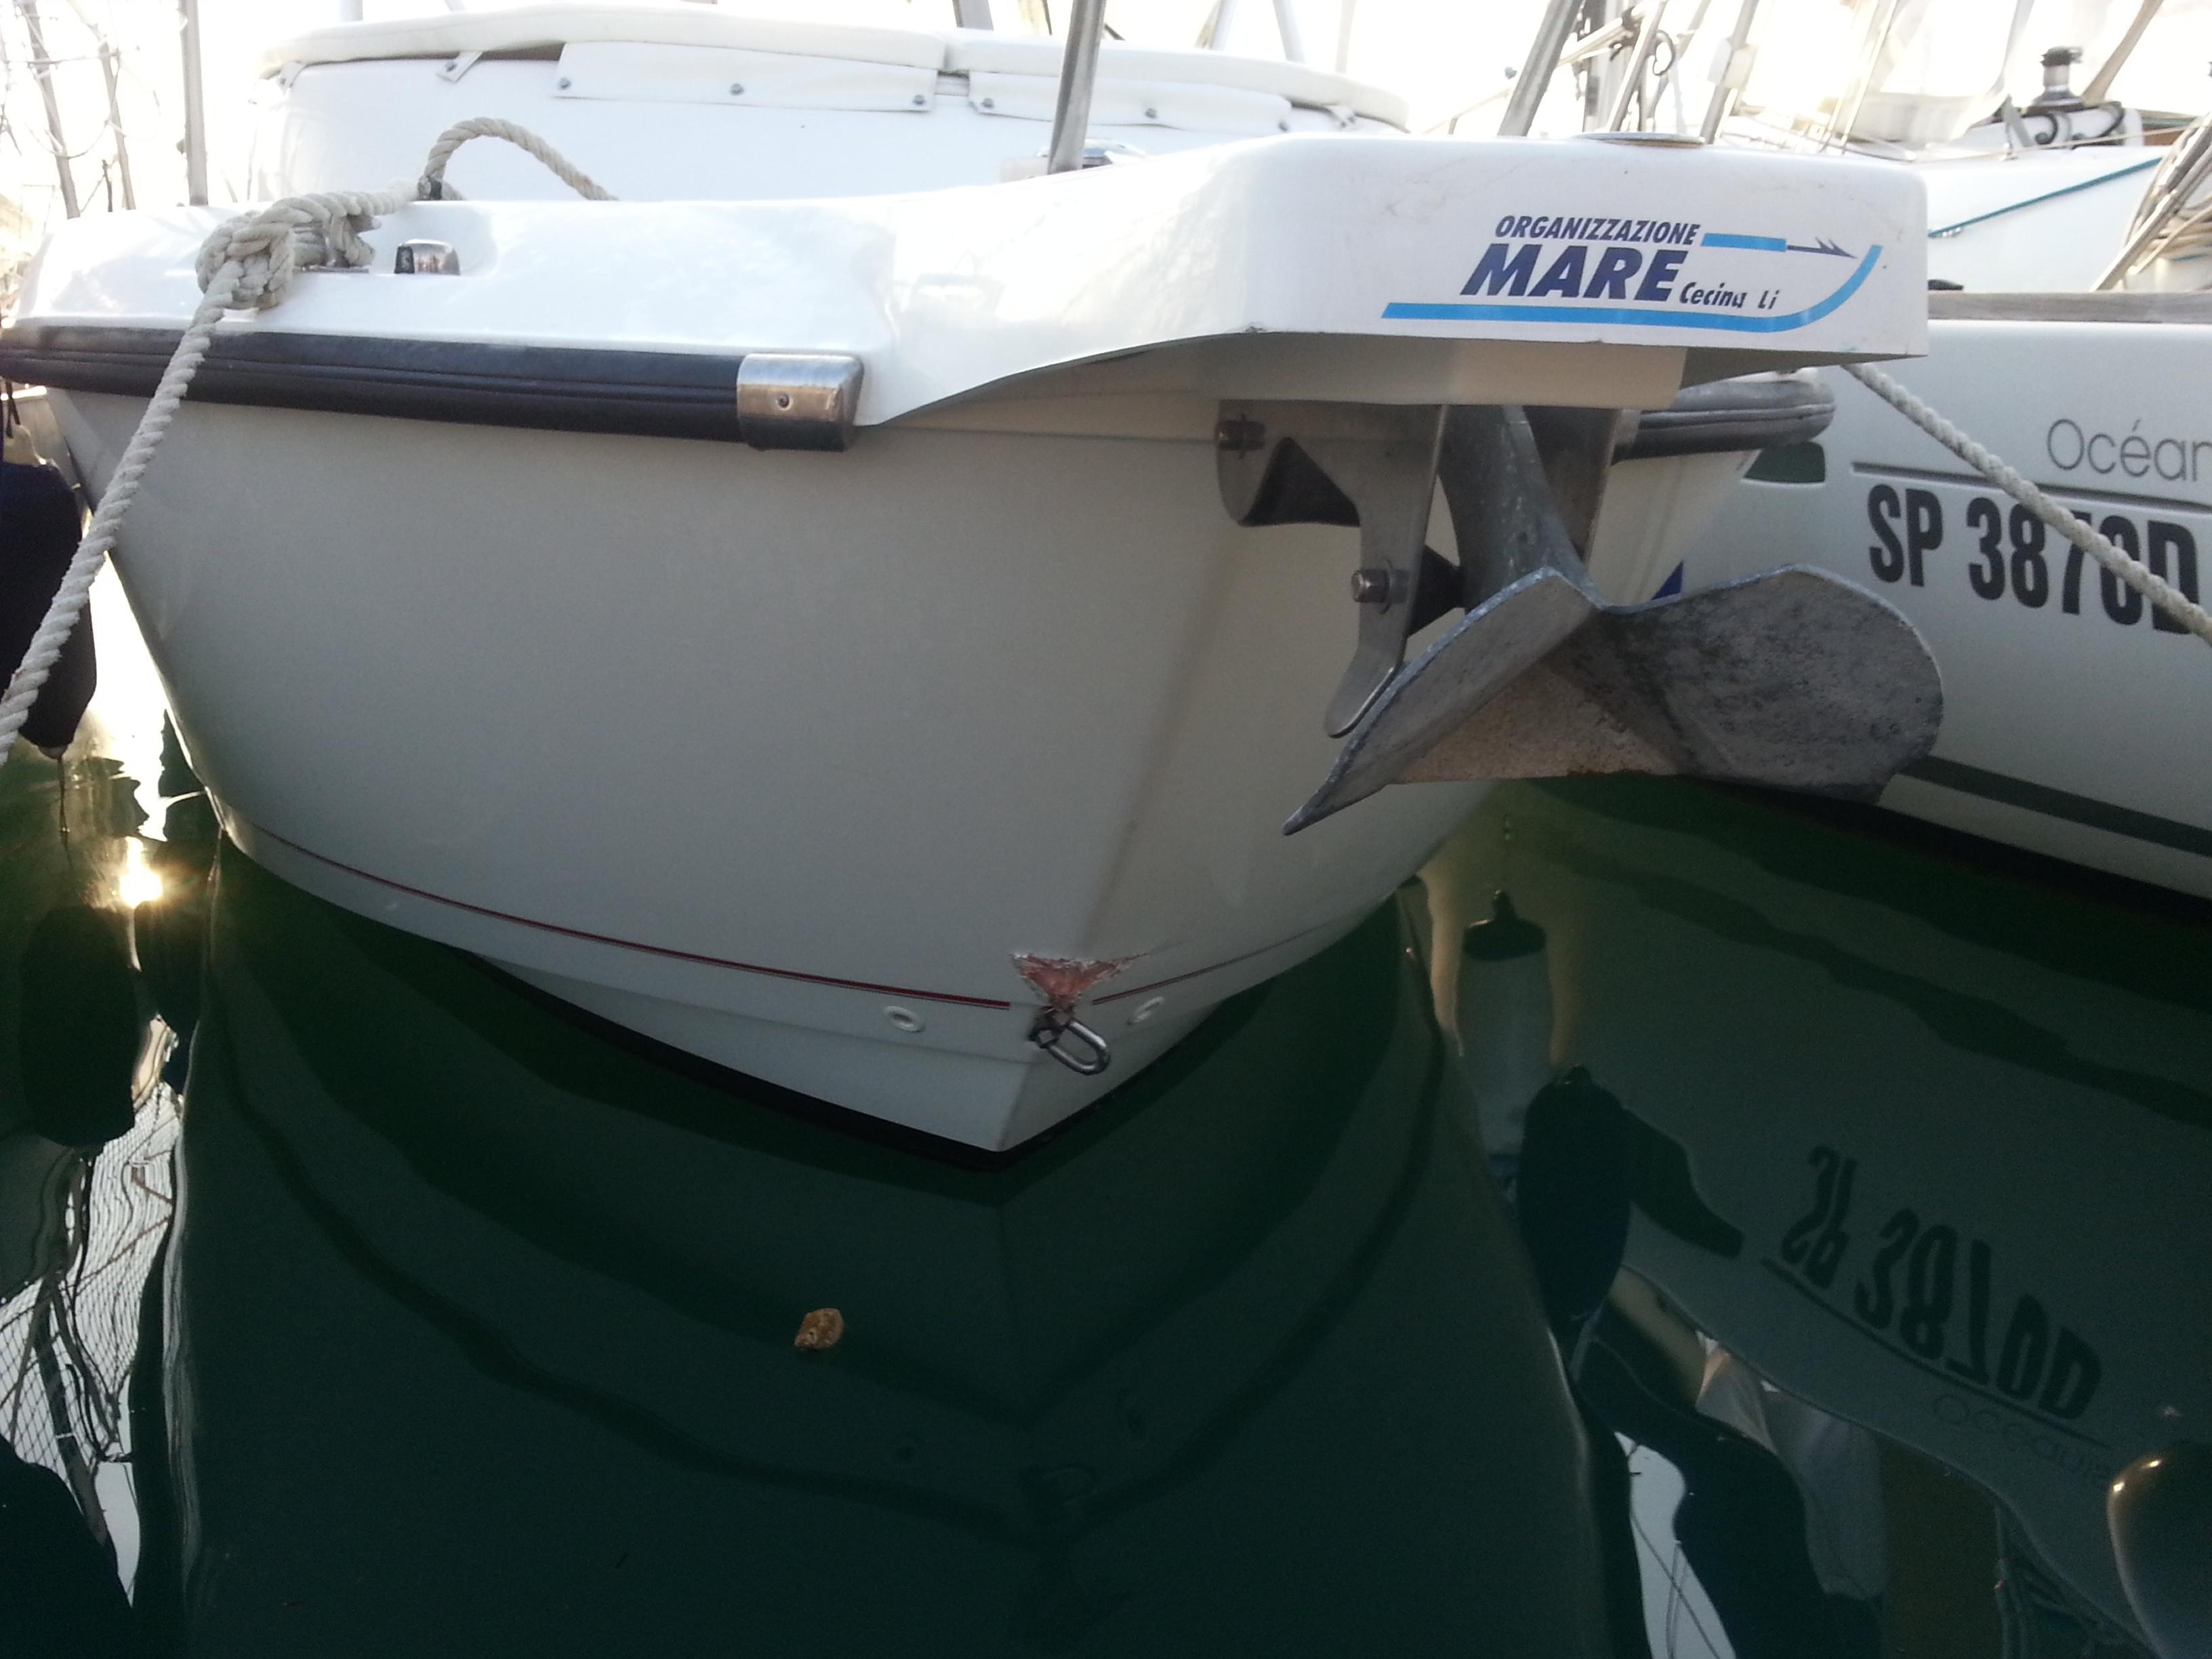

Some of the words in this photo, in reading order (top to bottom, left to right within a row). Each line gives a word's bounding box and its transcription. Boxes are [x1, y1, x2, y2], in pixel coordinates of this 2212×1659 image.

[1495, 215, 1700, 246] ORGANIZZAZIONE
[1460, 243, 1689, 302] MARE
[1679, 282, 1746, 308] Cecina
[1757, 289, 1780, 310] Li
[1866, 484, 1944, 588] SP
[1966, 496, 2200, 636] 3870D
